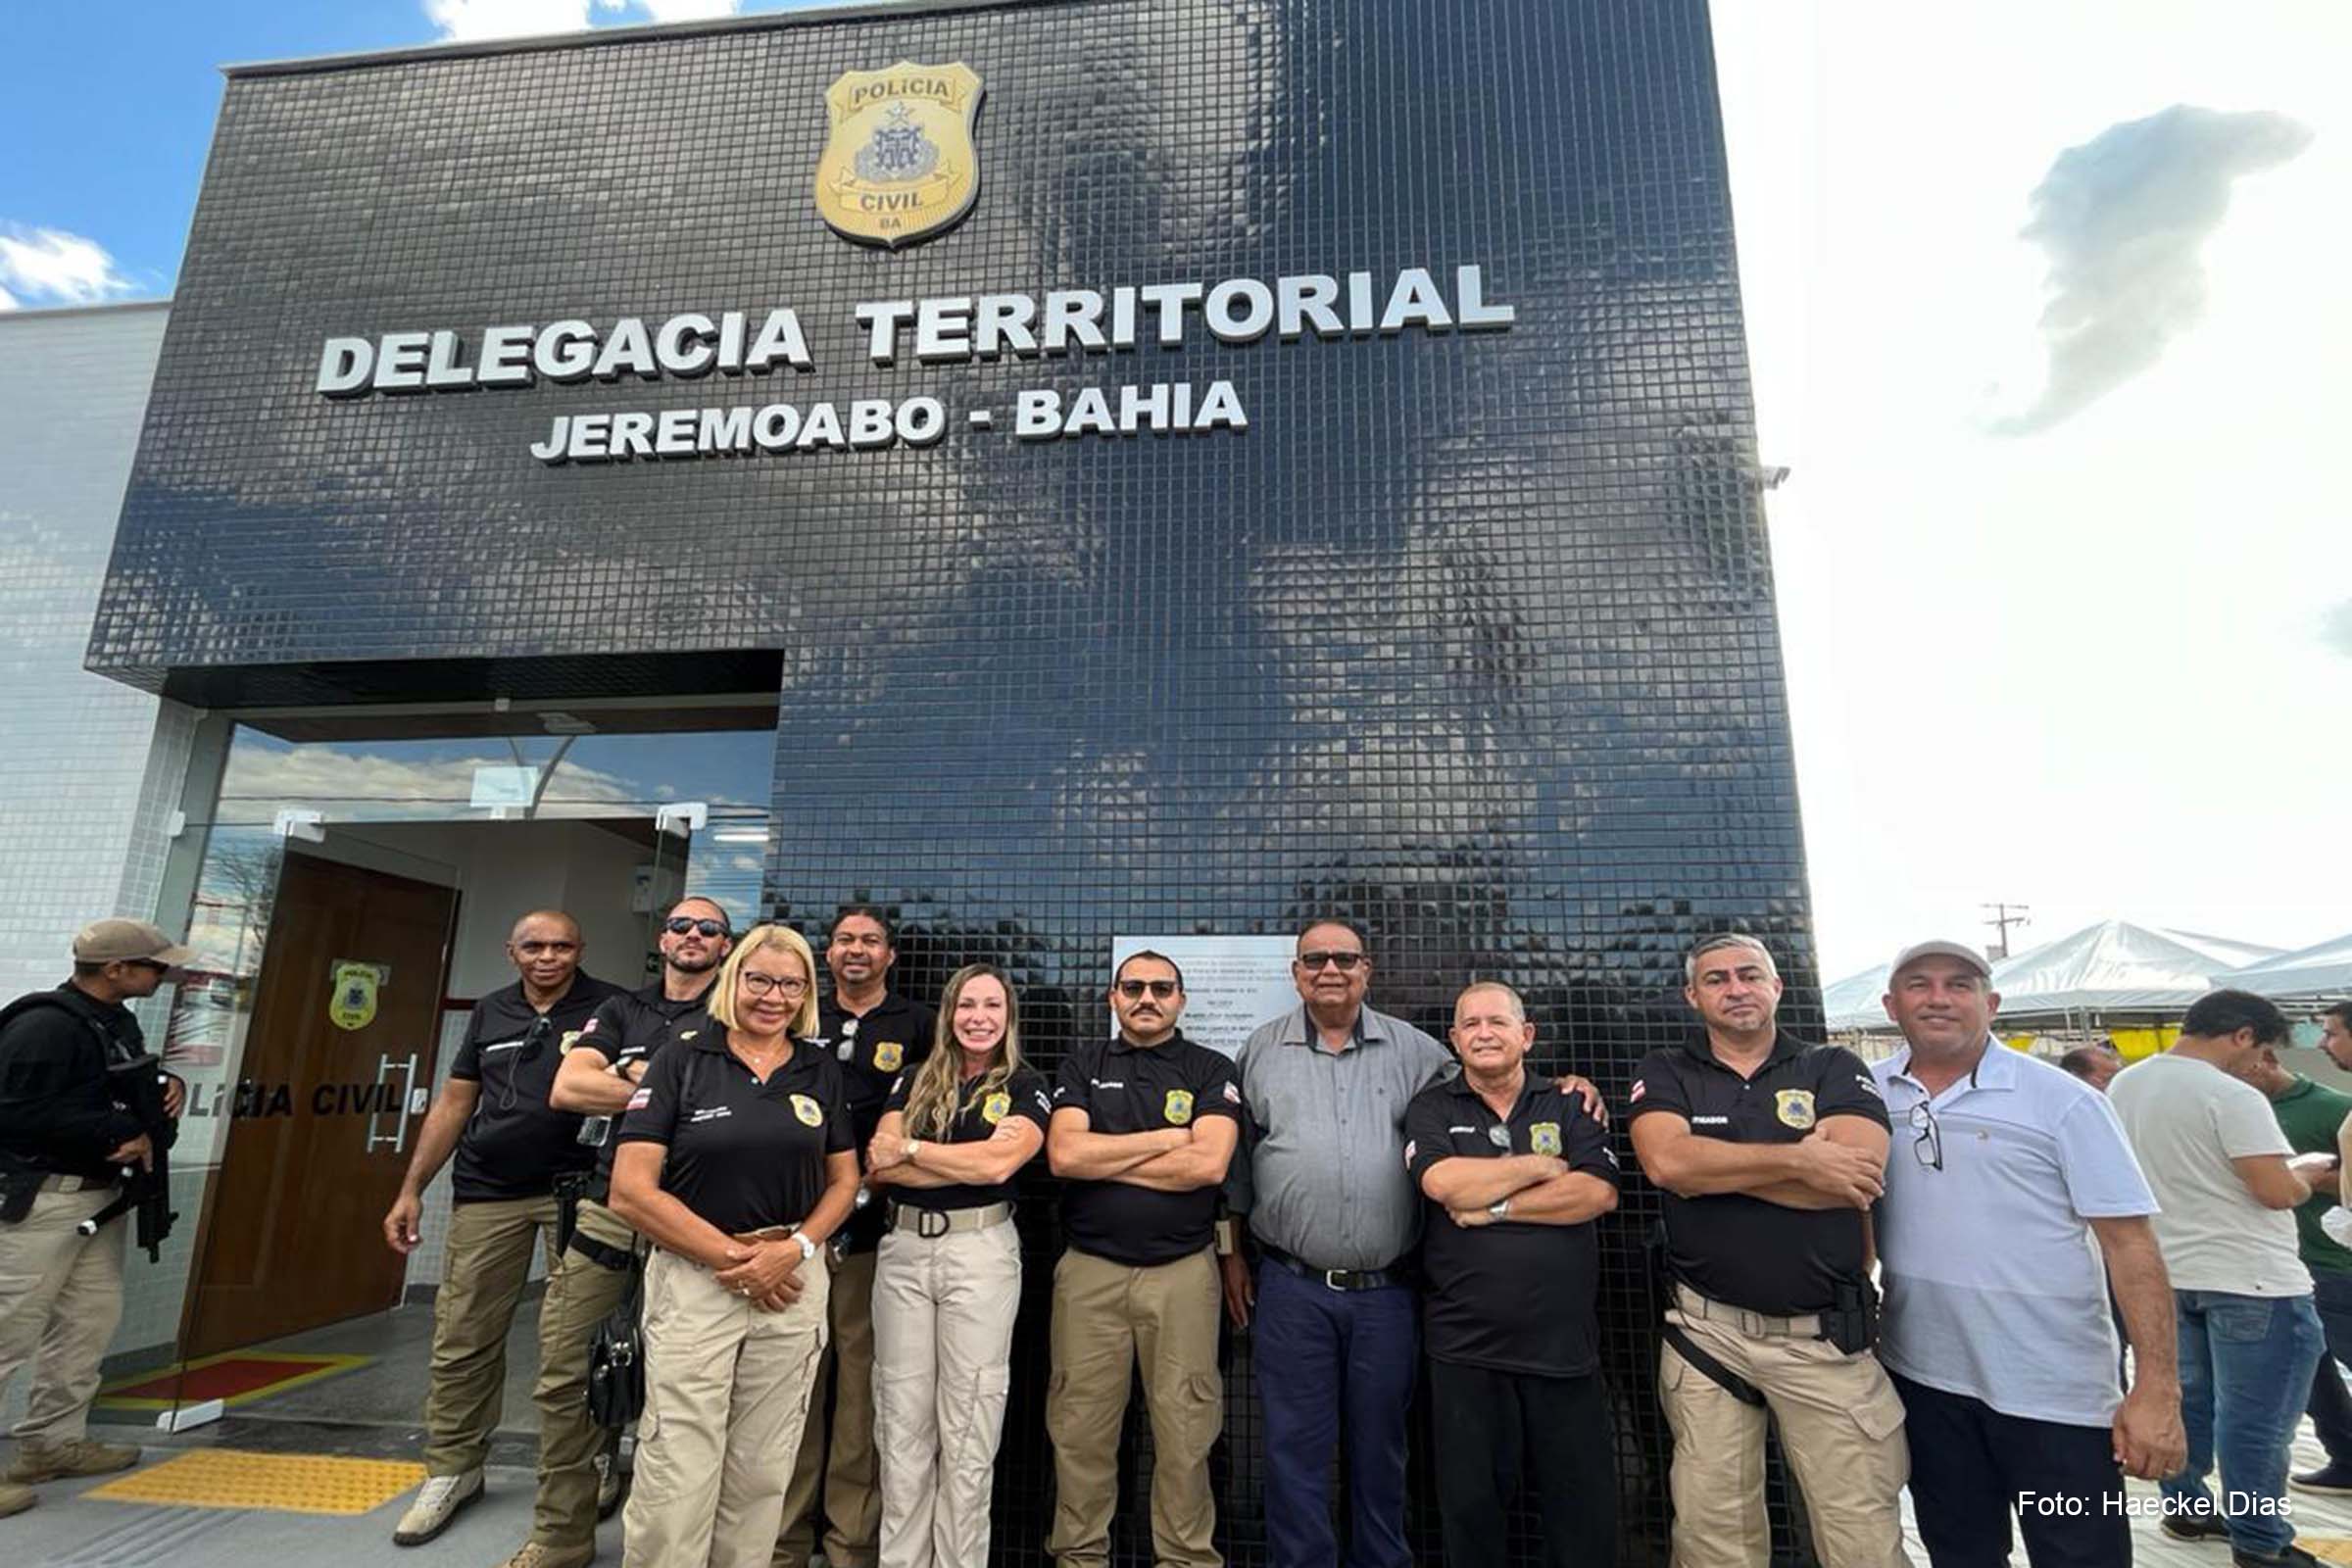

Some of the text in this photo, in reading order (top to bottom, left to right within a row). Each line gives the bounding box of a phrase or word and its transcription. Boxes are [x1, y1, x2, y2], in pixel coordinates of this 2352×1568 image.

[860, 192, 923, 211] CIVIL
[879, 218, 902, 230] BA
[316, 264, 1515, 398] DELEGACIA TERRITORIAL
[530, 395, 947, 466] JEREMOABO
[1014, 379, 1249, 440] BAHIA
[312, 1081, 404, 1115] CIVIL
